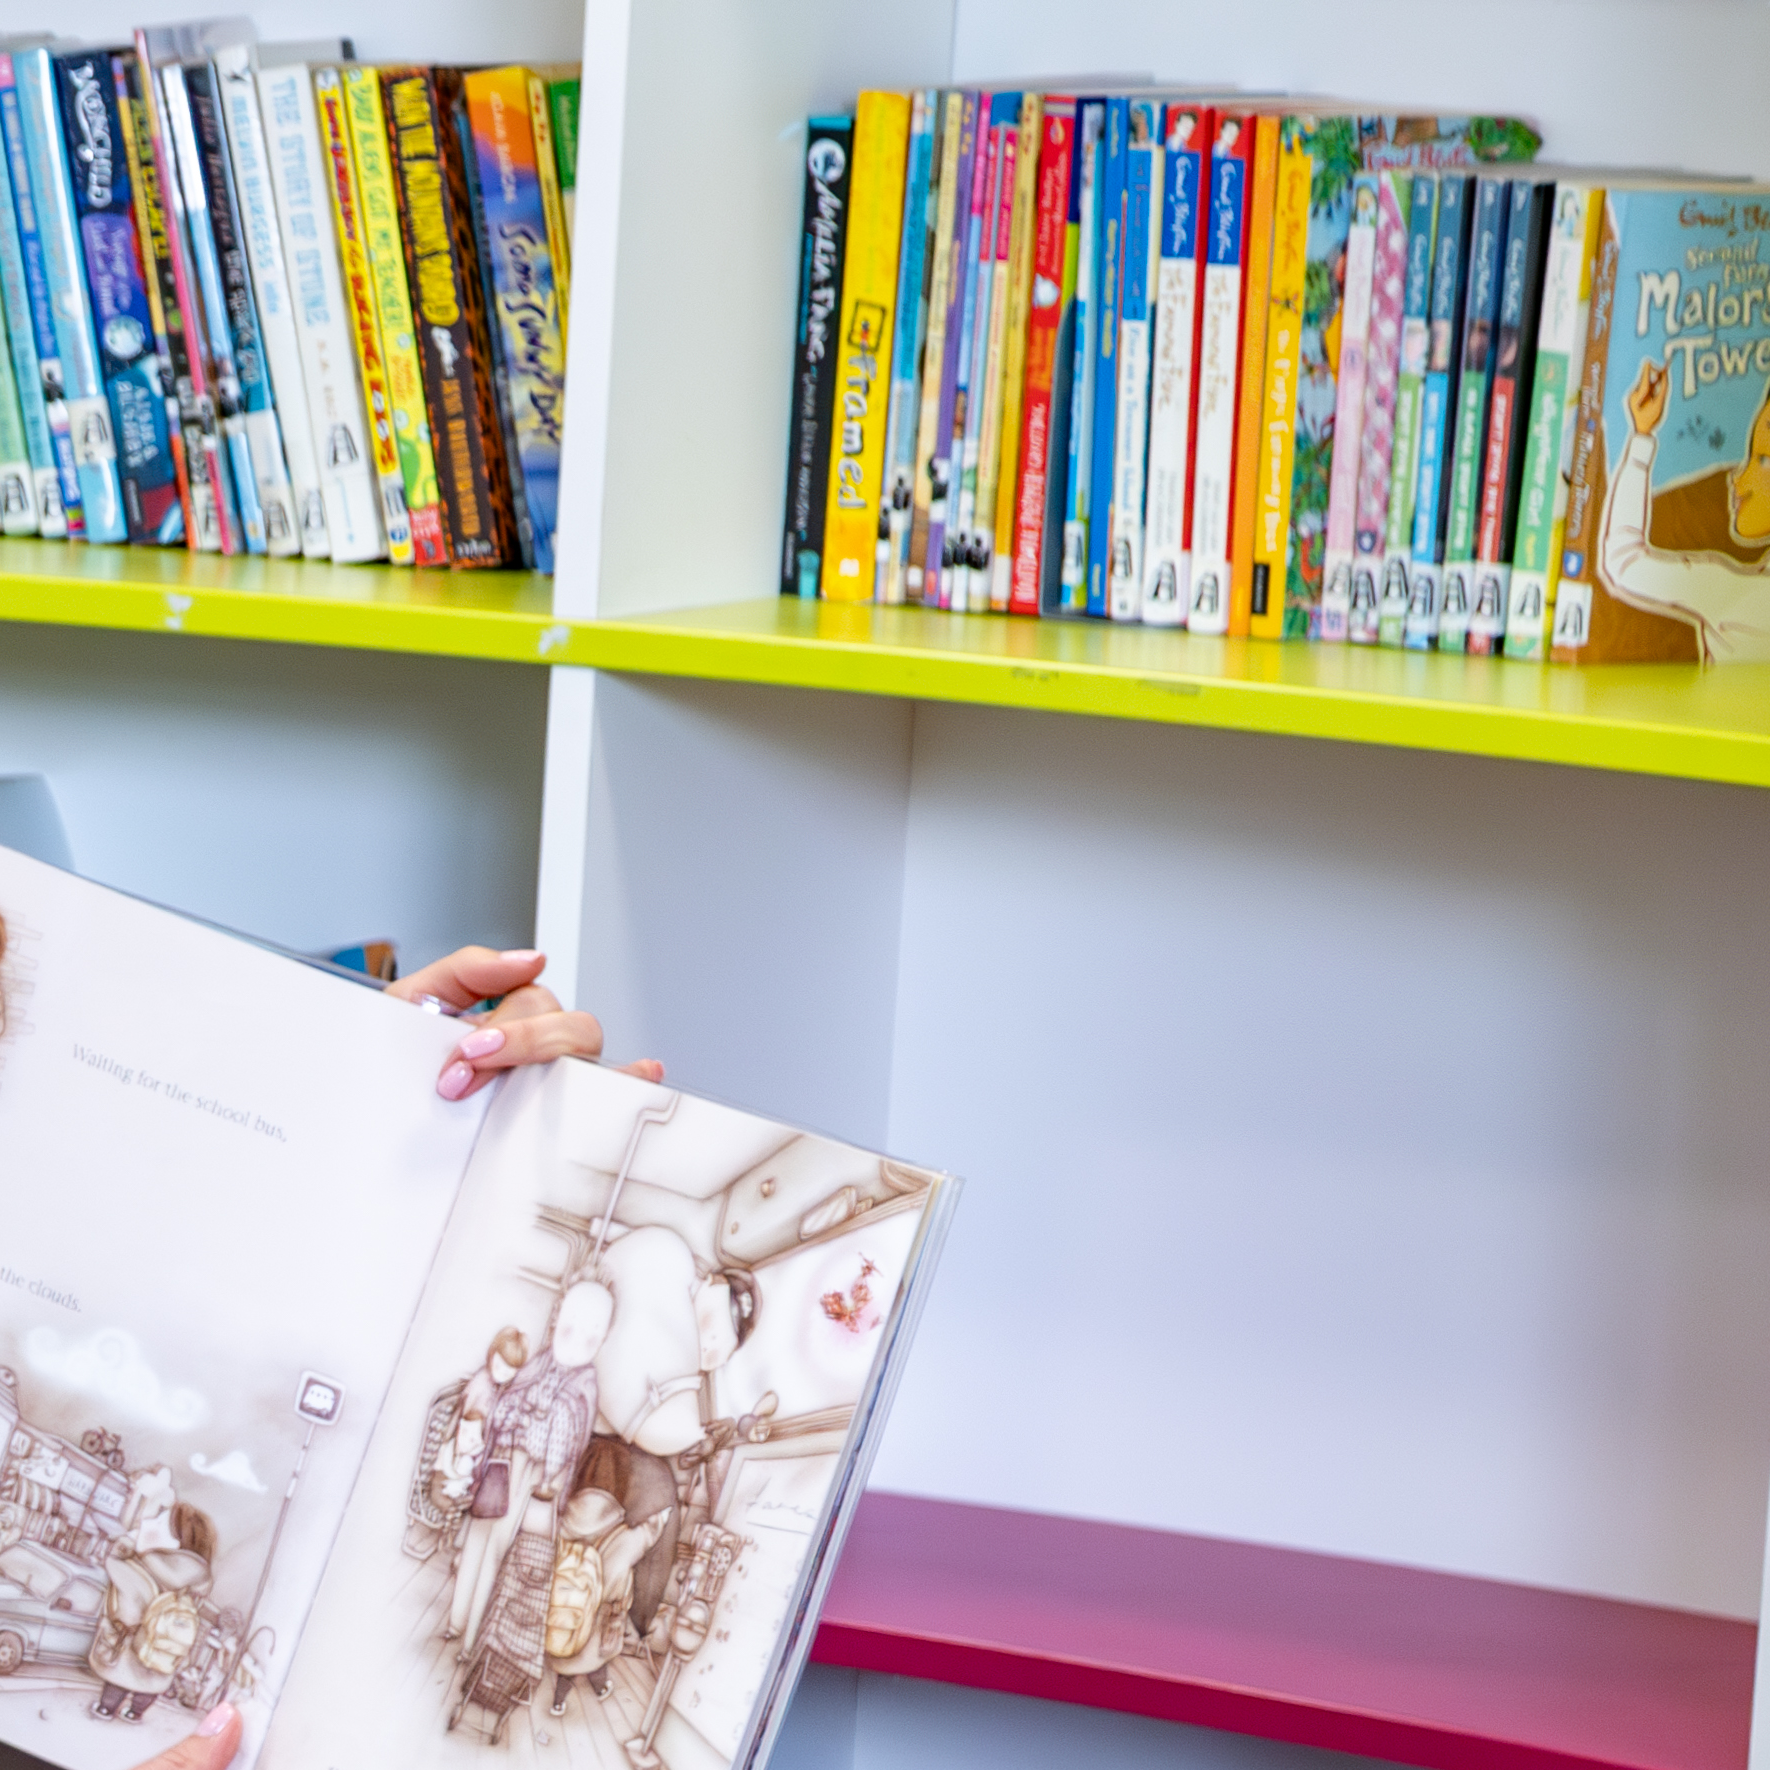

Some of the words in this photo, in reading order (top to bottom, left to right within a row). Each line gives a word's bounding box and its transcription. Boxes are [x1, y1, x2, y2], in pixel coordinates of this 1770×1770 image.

[270, 77, 299, 128] THE
[231, 95, 259, 172] MELVIN
[283, 133, 317, 211] STORY
[1168, 156, 1191, 192] Enid
[1218, 162, 1238, 199] Enid
[244, 177, 276, 270] BURGESS
[292, 213, 318, 241] OF
[1167, 194, 1193, 255] Blyton
[1214, 199, 1237, 261] Blyton
[1678, 200, 1738, 237] Enid
[499, 221, 538, 297] Some
[503, 299, 557, 389] Sunny
[1664, 331, 1770, 400] Towe
[530, 391, 563, 446] Day
[71, 1044, 133, 1086] Waiting
[136, 1068, 163, 1094] for
[164, 1080, 193, 1106] the
[195, 1094, 252, 1128] school
[252, 1115, 289, 1144] bus,
[27, 1274, 83, 1313] clouds.
